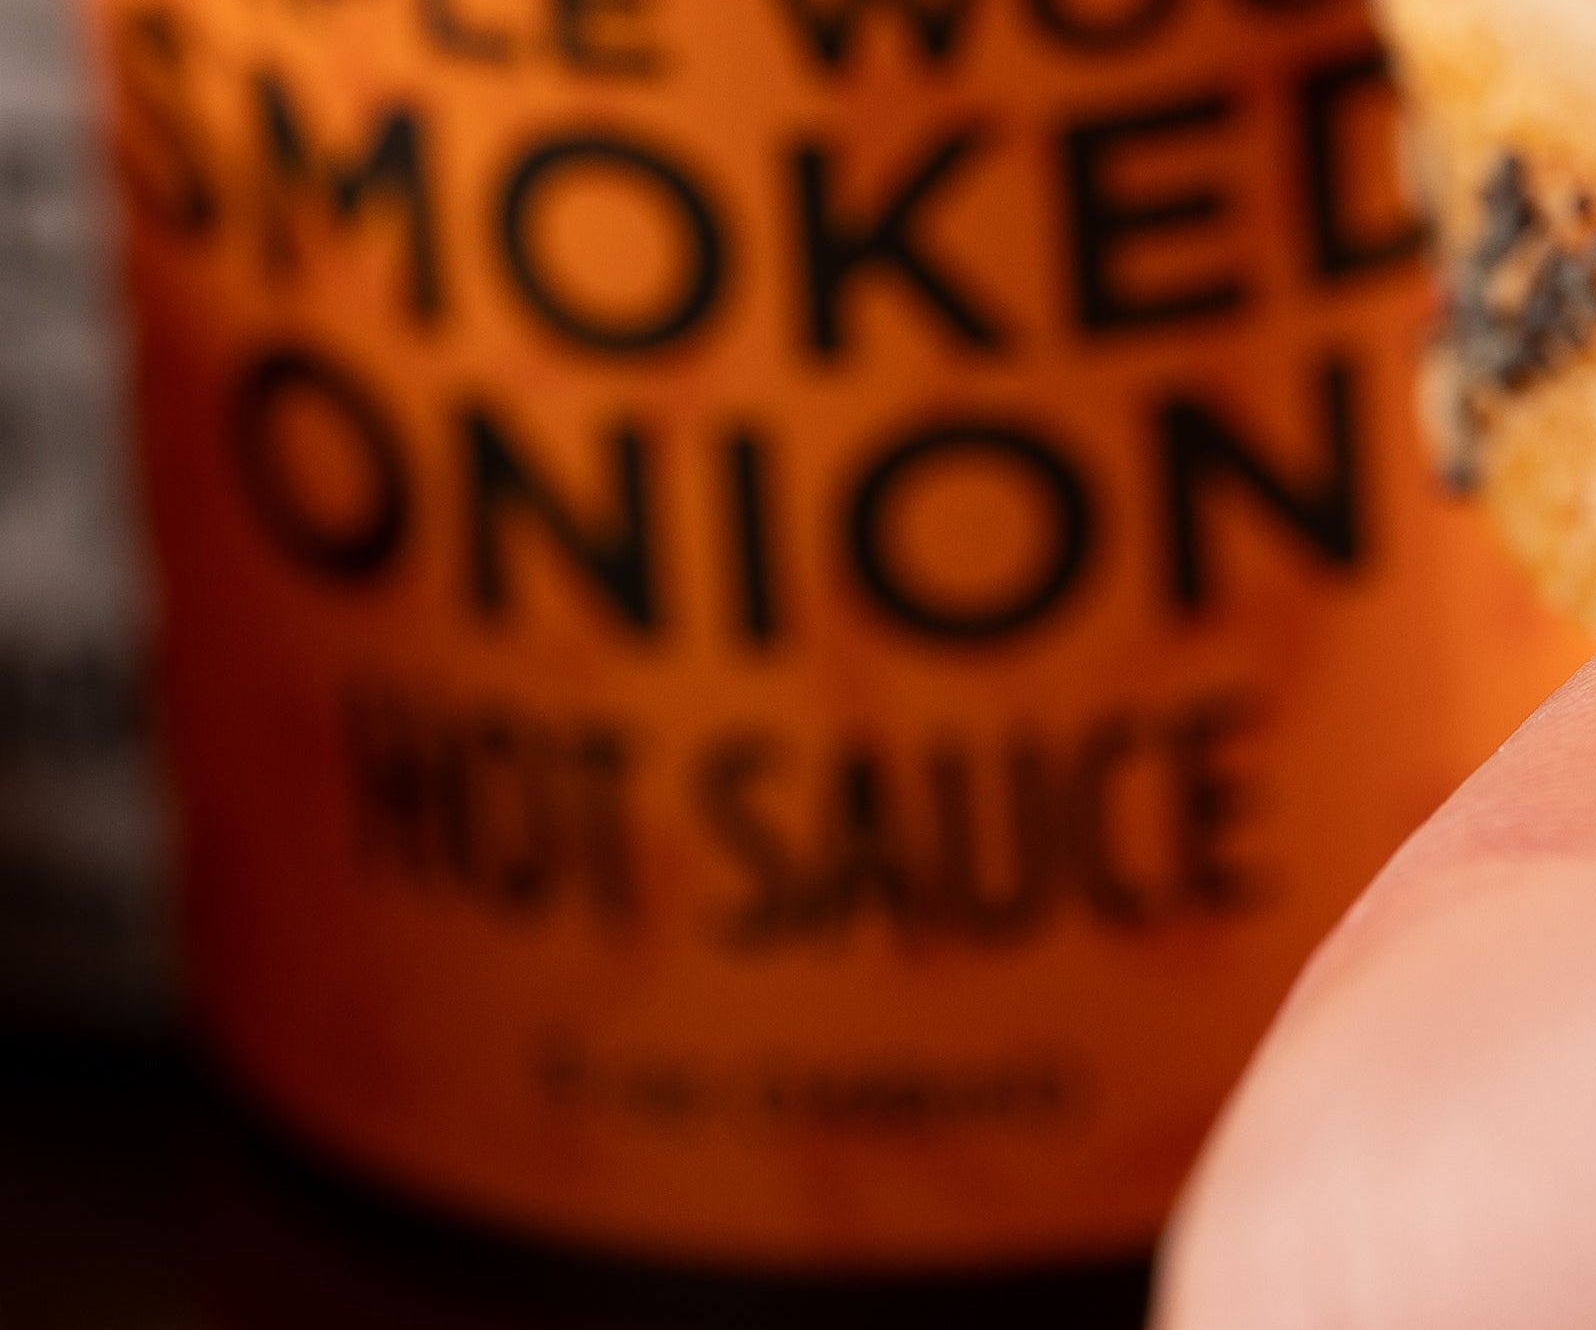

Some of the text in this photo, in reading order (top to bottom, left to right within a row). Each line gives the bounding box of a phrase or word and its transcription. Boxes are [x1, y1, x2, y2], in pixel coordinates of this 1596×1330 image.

[230, 350, 1368, 650] ONION
[343, 685, 648, 938] HOT
[691, 690, 1282, 960] SAUCE
